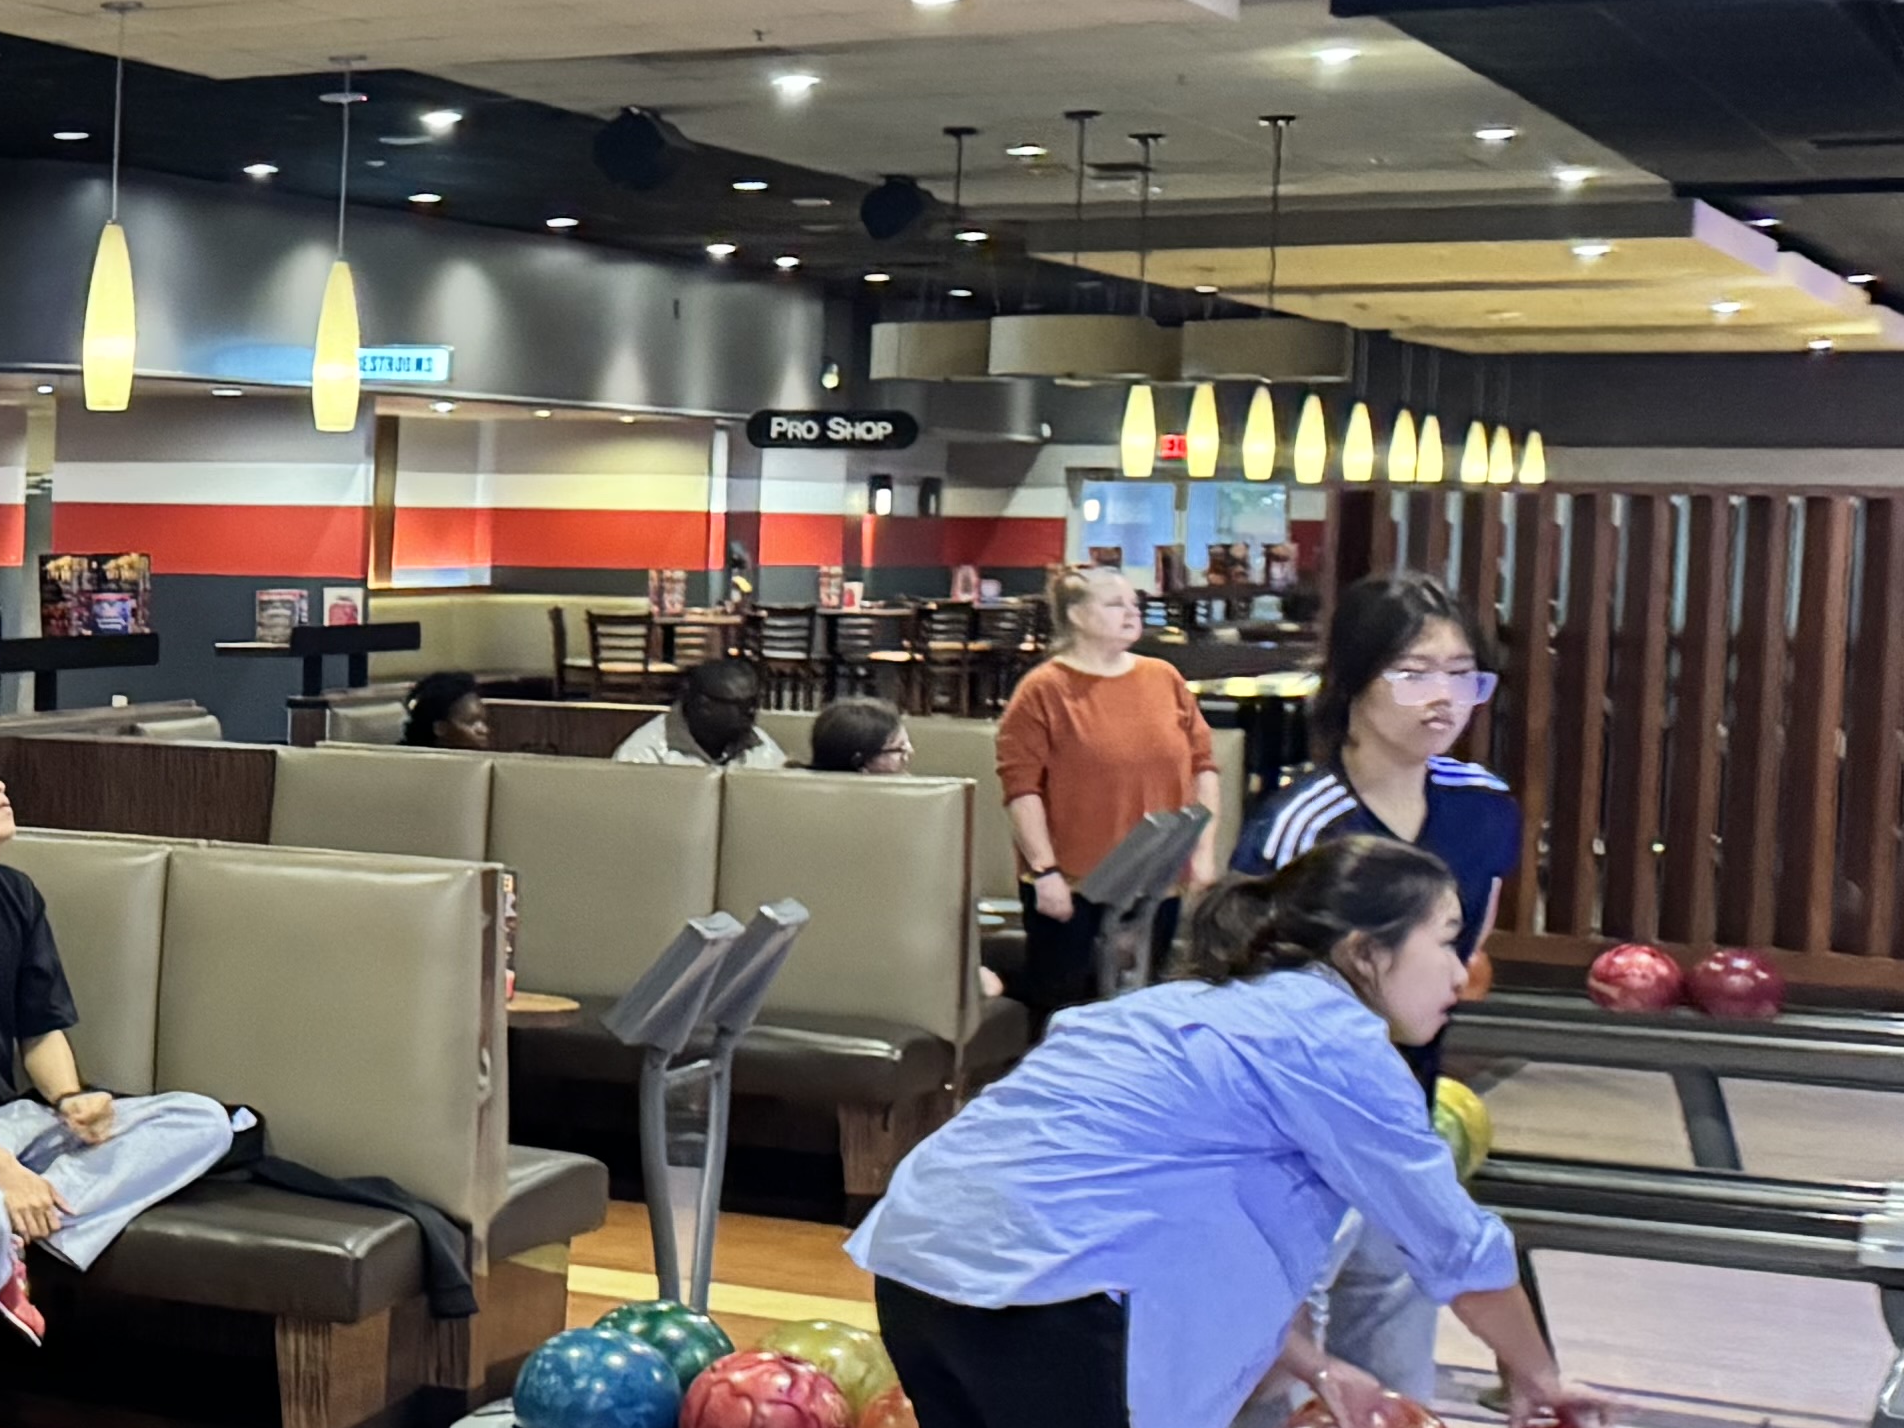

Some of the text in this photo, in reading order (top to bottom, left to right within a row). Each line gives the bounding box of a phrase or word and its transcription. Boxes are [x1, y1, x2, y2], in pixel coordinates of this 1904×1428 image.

[359, 355, 433, 373] ESTROOMS
[770, 416, 893, 441] PRO SHOP
